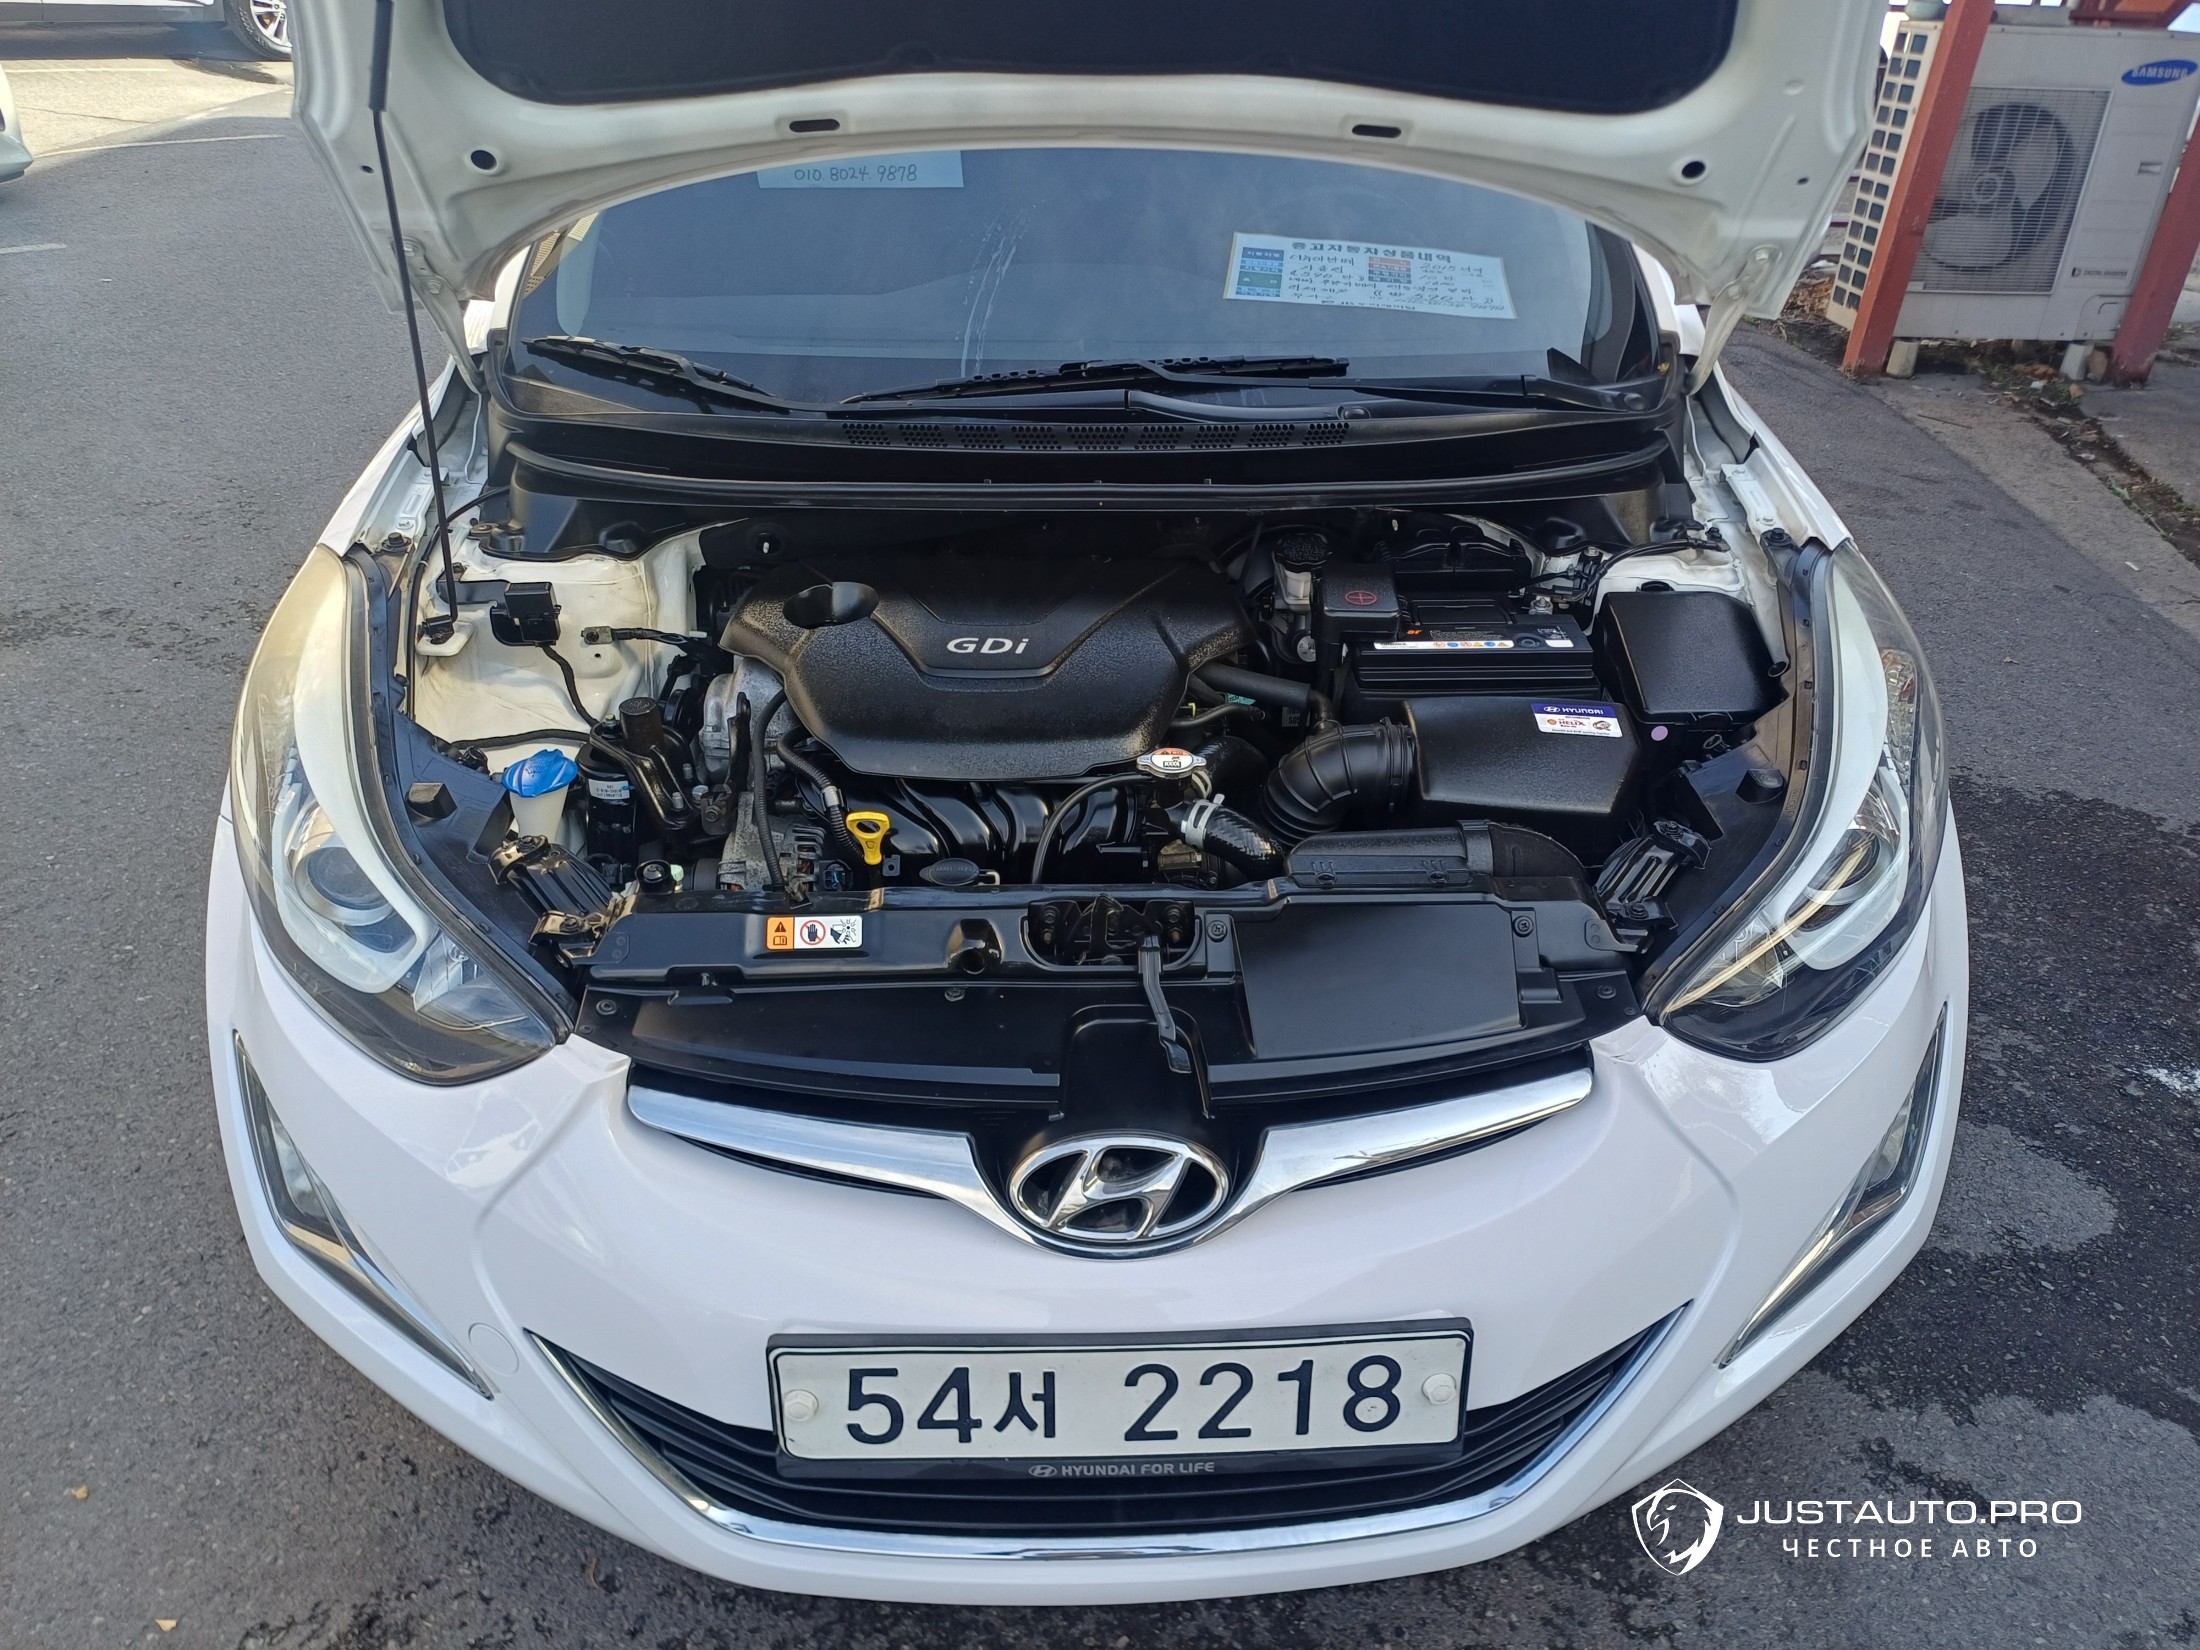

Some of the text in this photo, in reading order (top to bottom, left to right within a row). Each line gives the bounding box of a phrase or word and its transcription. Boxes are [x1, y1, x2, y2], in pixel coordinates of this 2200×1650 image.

[2131, 66, 2189, 79] SAMSUNG
[877, 163, 918, 183] 9878
[946, 637, 1029, 654] GDi
[1562, 707, 1604, 715] HYUNDAI
[846, 1354, 1403, 1445] 54서 2218
[1061, 1461, 1216, 1477] HYUNDAI FOR LIFE
